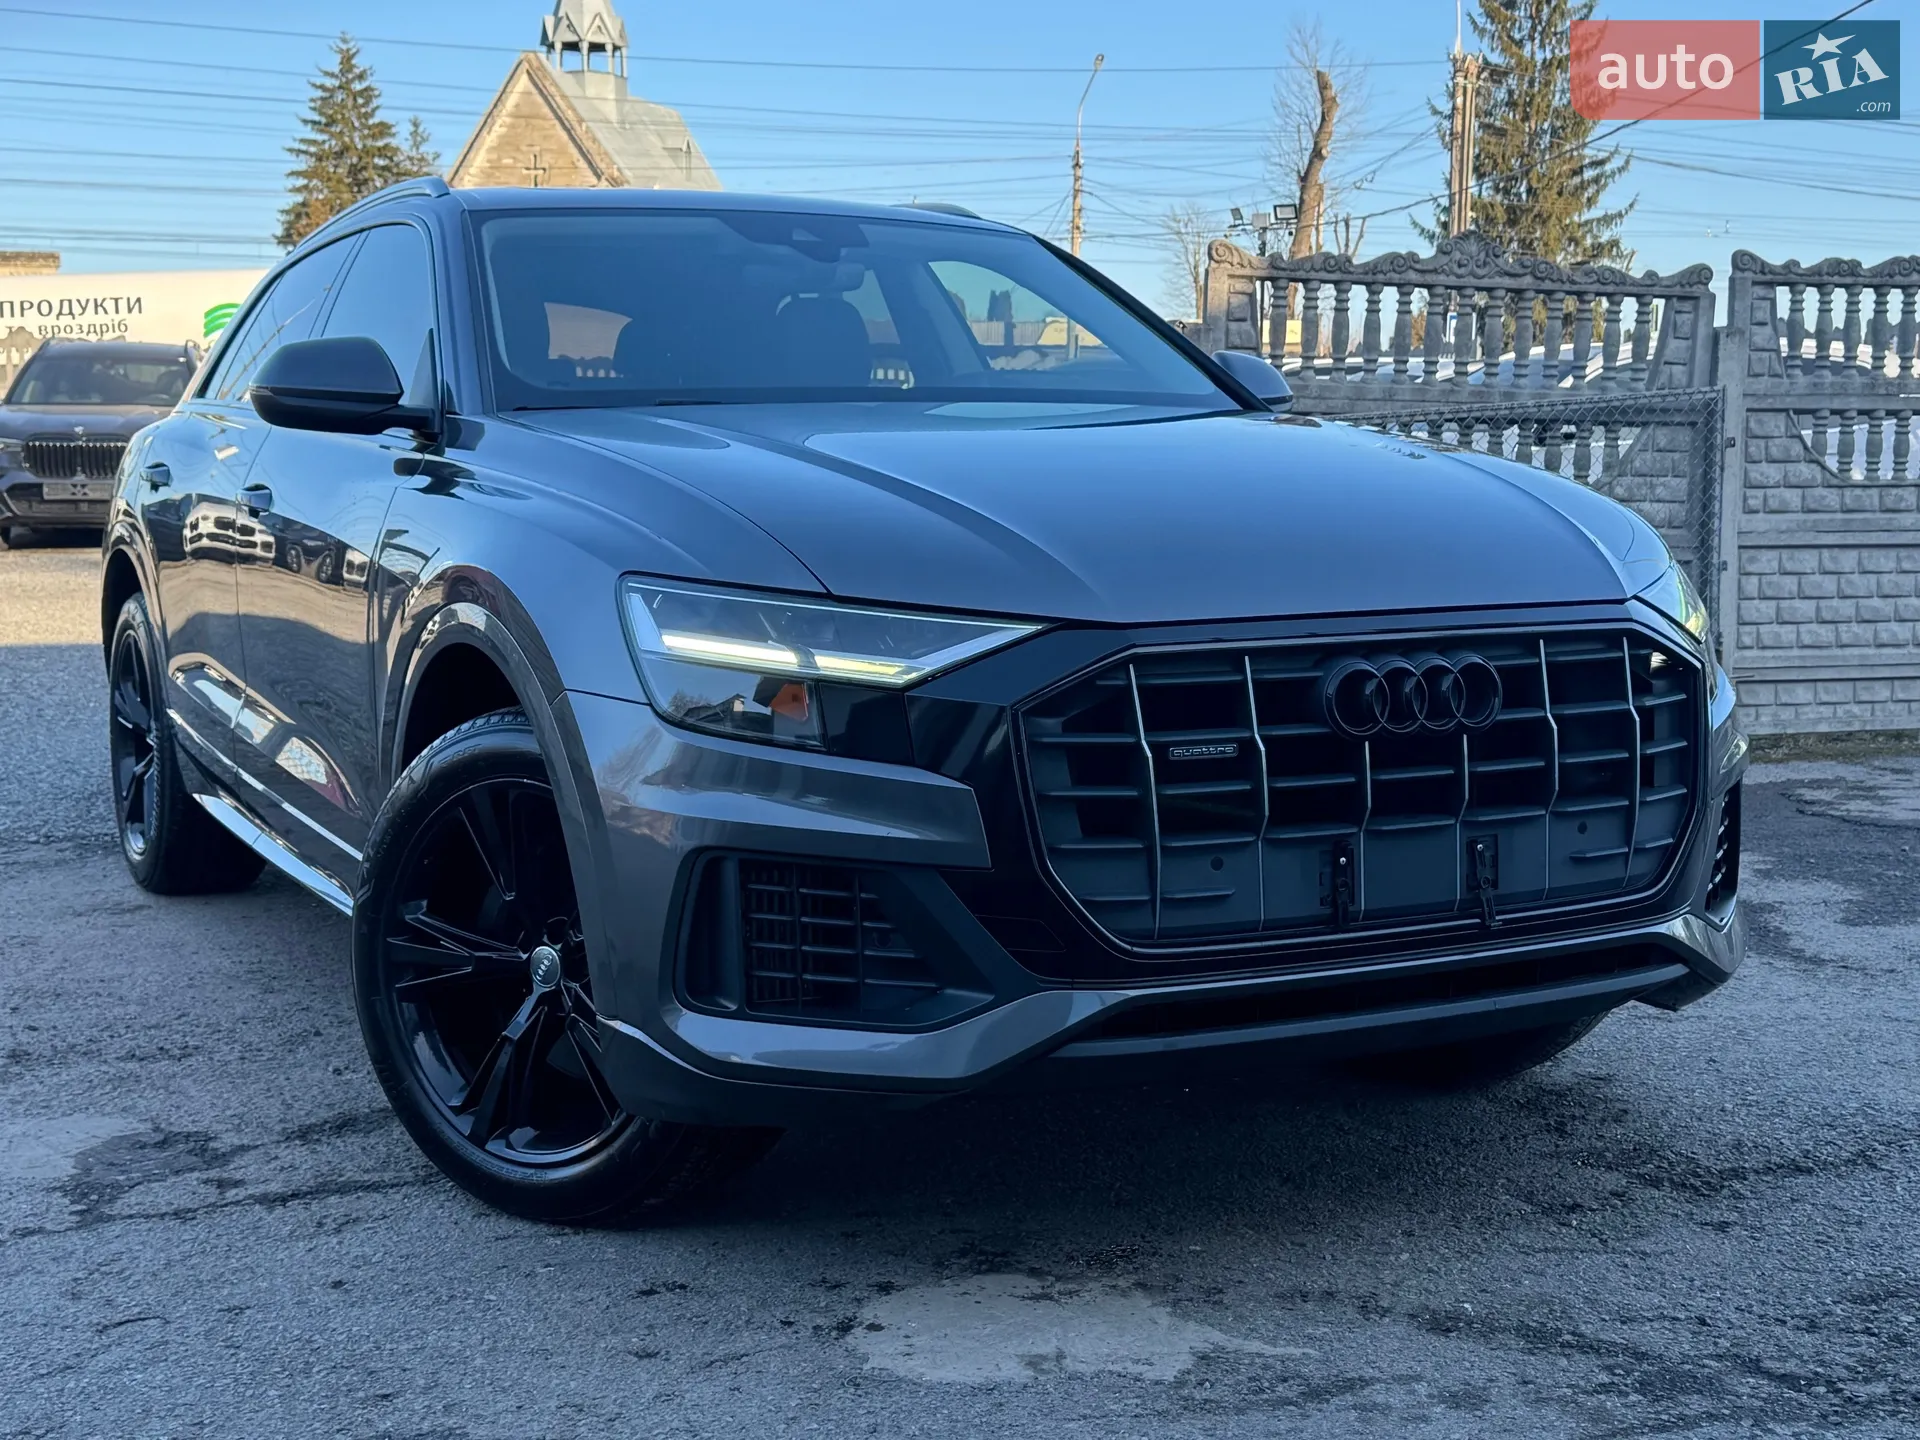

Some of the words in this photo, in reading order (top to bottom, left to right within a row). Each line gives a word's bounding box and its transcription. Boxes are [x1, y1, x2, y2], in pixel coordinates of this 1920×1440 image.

[0, 296, 143, 321] ПРОДУКТИ
[38, 318, 129, 339] вроздріб
[1173, 746, 1235, 758] quattro
